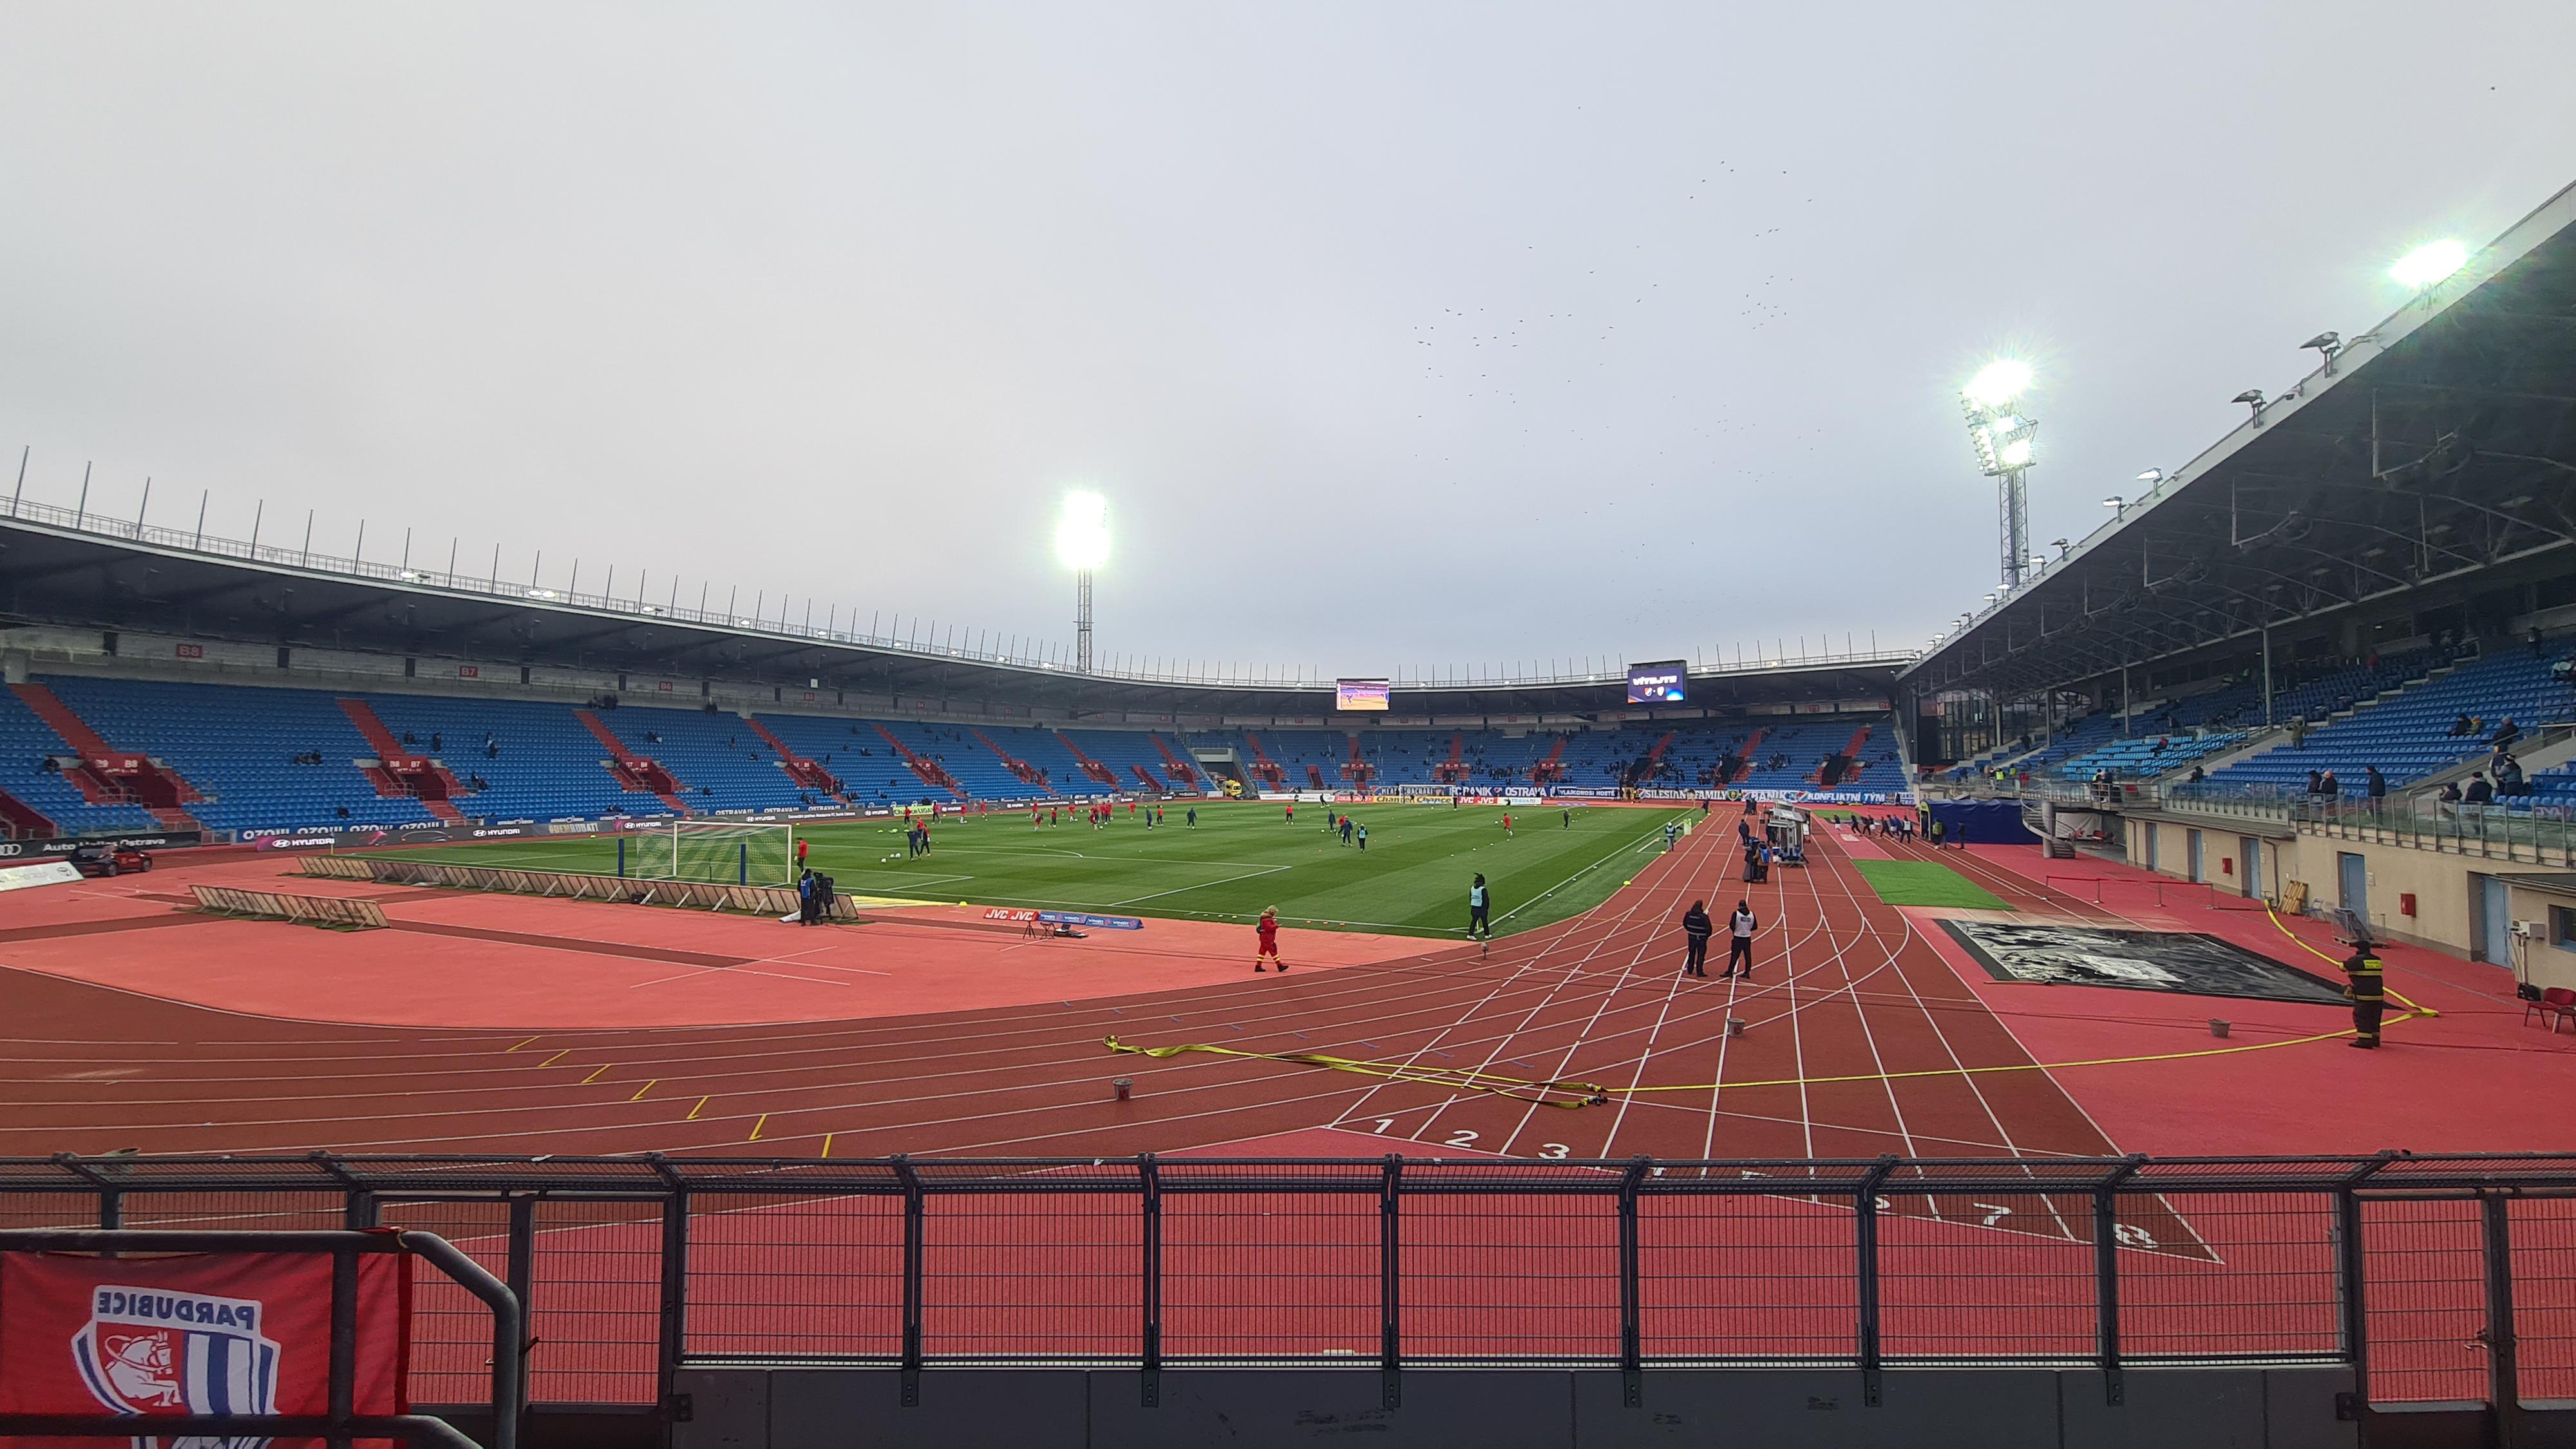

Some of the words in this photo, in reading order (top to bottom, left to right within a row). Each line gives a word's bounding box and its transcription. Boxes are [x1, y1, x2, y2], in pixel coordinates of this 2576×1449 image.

[461, 667, 476, 676] B7
[1505, 787, 1547, 796] OSTRAVA
[1645, 790, 1686, 799] SILESIAN
[1694, 791, 1727, 800] FAMILY
[1807, 792, 1861, 802] KONFLIKTNÍ
[1864, 792, 1886, 802] TÝM
[43, 843, 77, 851] Auto
[292, 838, 335, 846] HYUNDAI
[985, 909, 1009, 919] JVC
[1010, 911, 1035, 921] JVC
[1374, 1119, 1394, 1134] 1
[1445, 1130, 1479, 1148] 2
[1539, 1143, 1571, 1159] 3
[1973, 1202, 2012, 1226] 7
